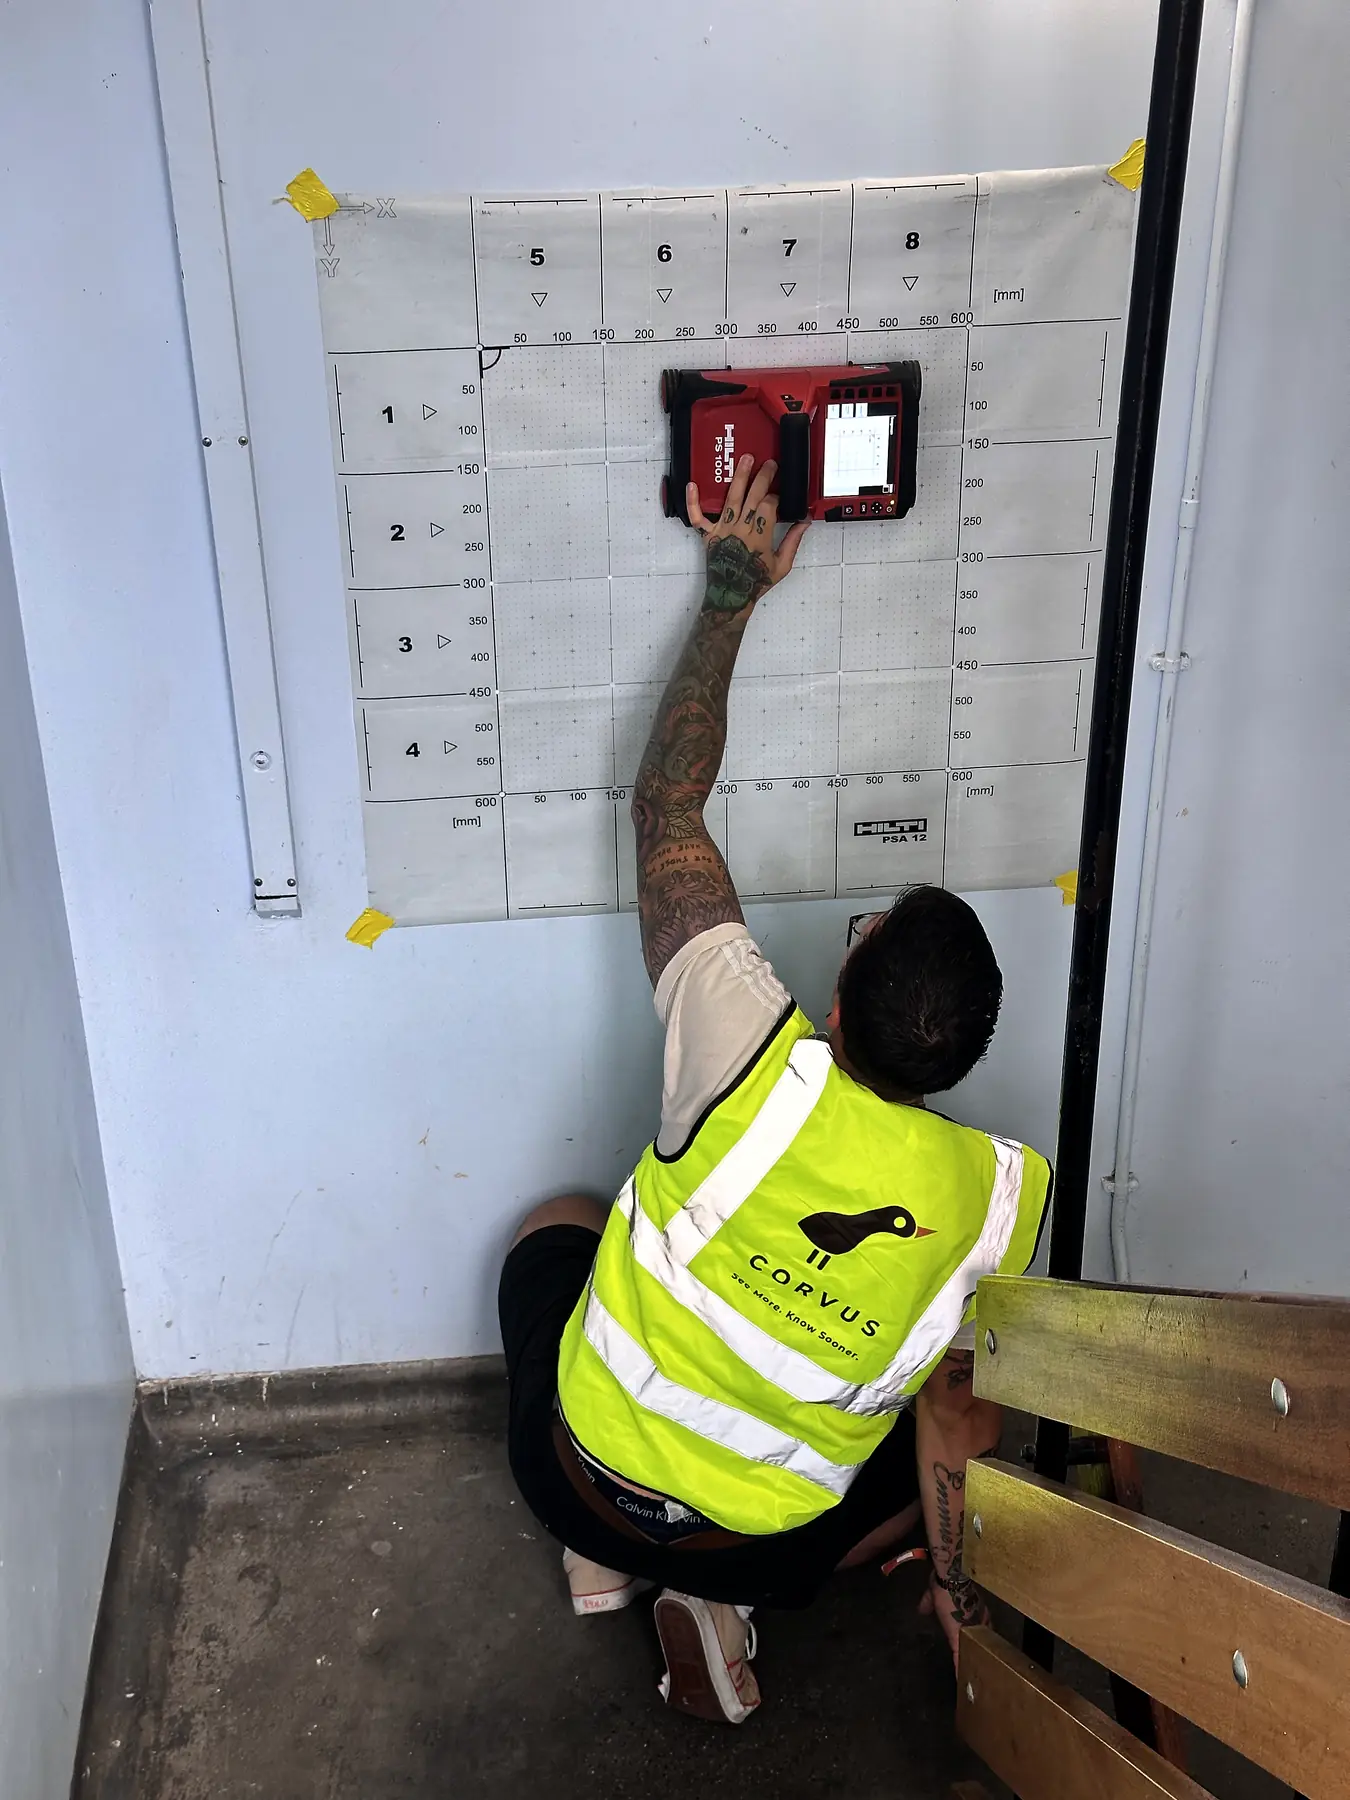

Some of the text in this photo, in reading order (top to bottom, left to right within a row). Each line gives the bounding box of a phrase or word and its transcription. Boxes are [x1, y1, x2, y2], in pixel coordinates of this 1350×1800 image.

[376, 198, 397, 218] X
[529, 231, 920, 267] 5 6 7 8
[319, 257, 341, 279] Y
[993, 287, 1025, 304] [mm]
[513, 312, 974, 344] 50 100 150 200 250 300 350 400 450 500 550 600
[970, 361, 984, 372] 50
[462, 384, 476, 395] 50
[969, 400, 988, 411] 100
[381, 405, 394, 424] 1
[458, 425, 478, 436] 100
[967, 437, 989, 450] 150
[714, 436, 723, 483] PS 1000
[724, 424, 735, 483] HILTI
[457, 463, 480, 475] 150
[964, 478, 984, 488] 200
[462, 503, 482, 514] 200
[963, 516, 982, 526] 250
[390, 524, 406, 542] 2
[464, 542, 484, 552] 250
[961, 551, 984, 563] 300
[463, 577, 486, 589] 300
[959, 590, 978, 600] 350
[468, 616, 488, 626] 350
[957, 626, 977, 636] 400
[398, 636, 413, 653] 3
[470, 652, 490, 662] 400
[956, 659, 978, 671] 450
[469, 686, 492, 698] 450
[954, 696, 973, 706] 500
[475, 722, 494, 733] 500
[953, 730, 971, 740] 550
[405, 742, 421, 758] 4
[476, 756, 495, 766] 550
[951, 770, 973, 782] 600
[534, 773, 921, 804] 50 100 150 300 350 400 450 500 550
[966, 785, 994, 798] [mm]
[475, 797, 497, 808] 600
[452, 815, 481, 829] [mm]
[856, 820, 926, 836] HILTI
[882, 833, 927, 844] PSA 12
[749, 1254, 881, 1338] CORVUS
[731, 1272, 859, 1361] See More. Know Sooner.
[616, 1495, 654, 1519] Calvin
